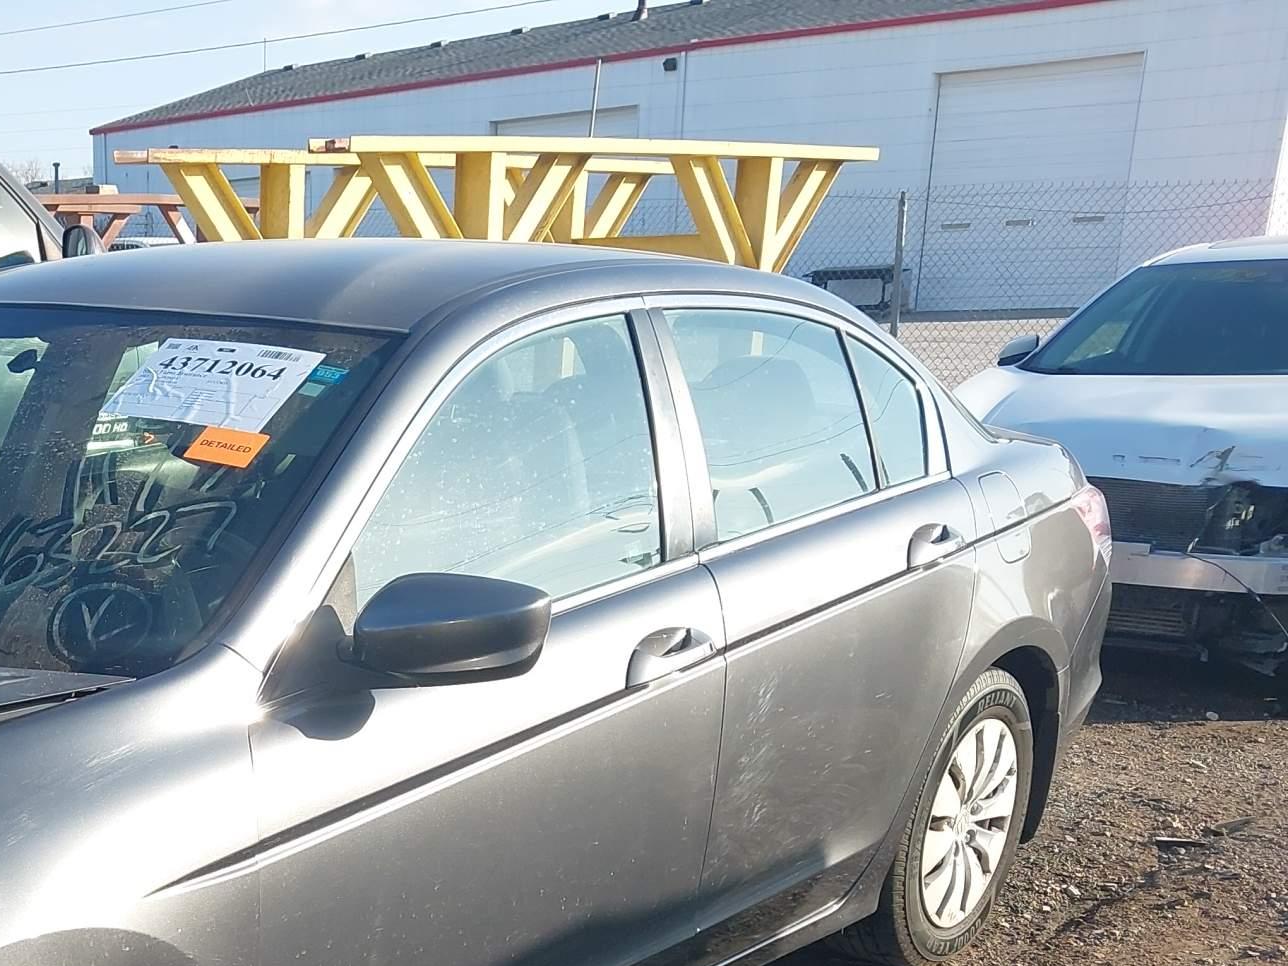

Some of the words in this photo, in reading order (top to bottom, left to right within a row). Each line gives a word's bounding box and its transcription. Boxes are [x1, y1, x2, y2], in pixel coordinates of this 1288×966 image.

[159, 355, 287, 380] 43712064
[199, 439, 252, 454] DETAILED
[976, 690, 1018, 714] RELIANT
